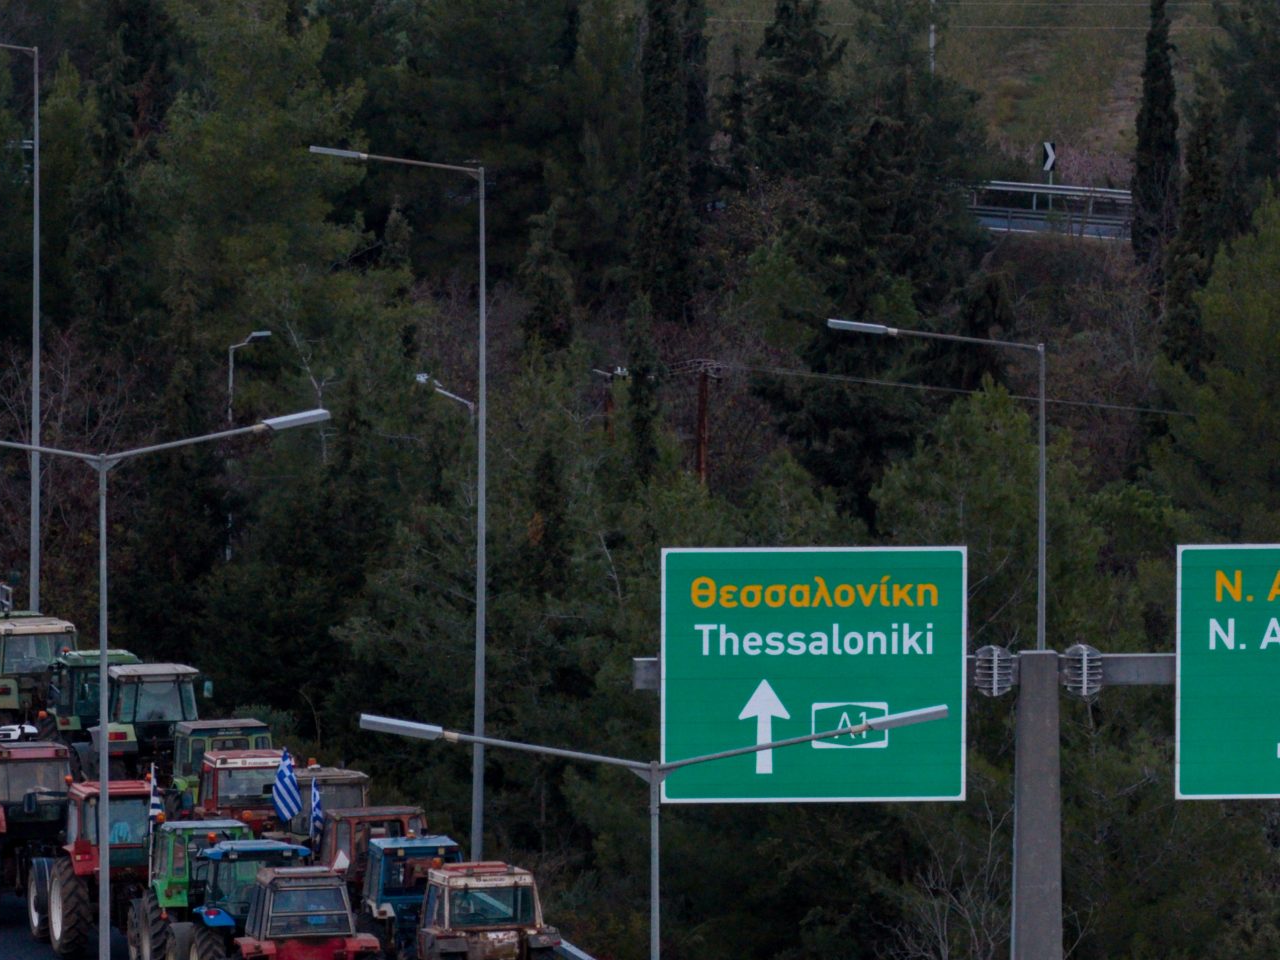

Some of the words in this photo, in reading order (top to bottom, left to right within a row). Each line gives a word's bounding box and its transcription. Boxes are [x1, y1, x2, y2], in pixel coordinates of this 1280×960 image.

[690, 575, 938, 608] Θεσσαλονίκη
[694, 623, 934, 656] Thessaloniki
[833, 711, 868, 739] A1
